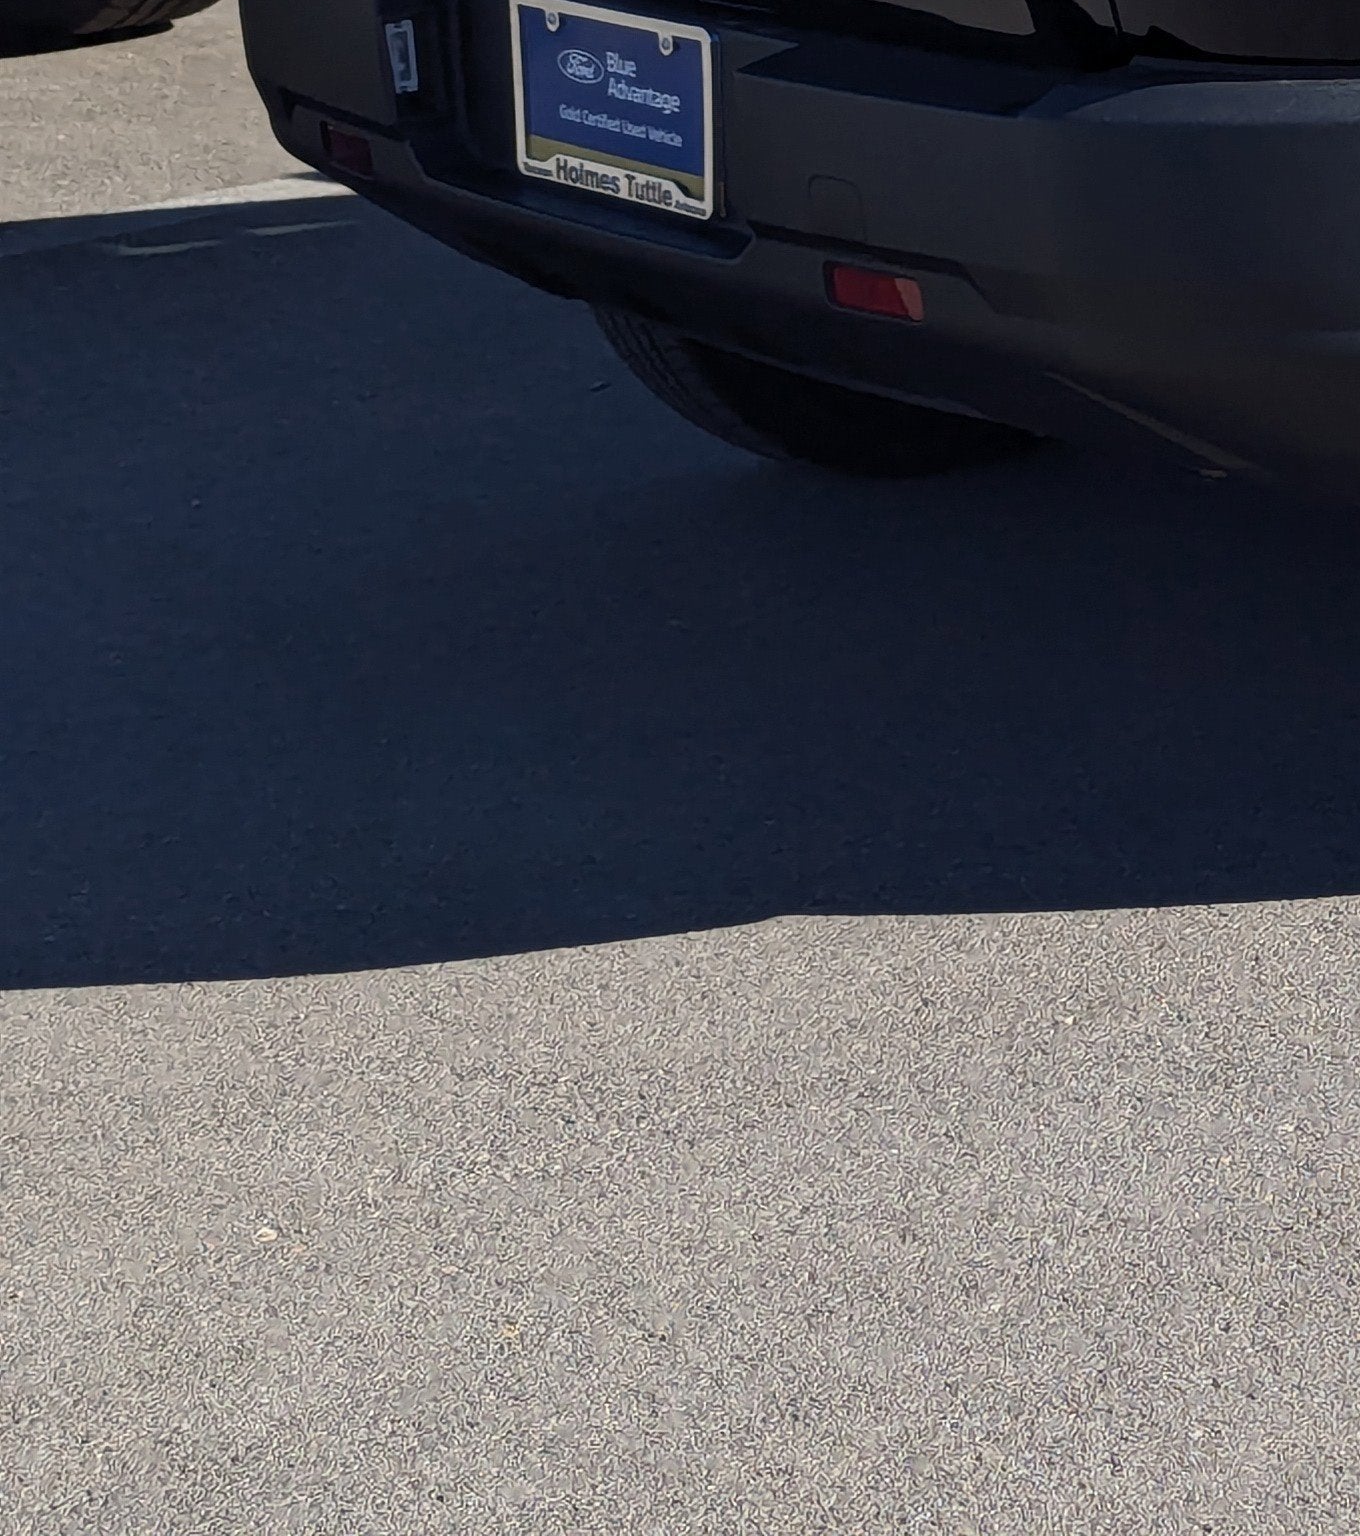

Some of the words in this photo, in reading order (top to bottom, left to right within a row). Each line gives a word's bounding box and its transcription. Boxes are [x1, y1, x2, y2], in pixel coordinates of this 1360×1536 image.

[606, 51, 637, 78] Blue
[607, 77, 681, 114] Advantage
[556, 157, 621, 195] Holmes
[625, 173, 673, 207] Tuttle
